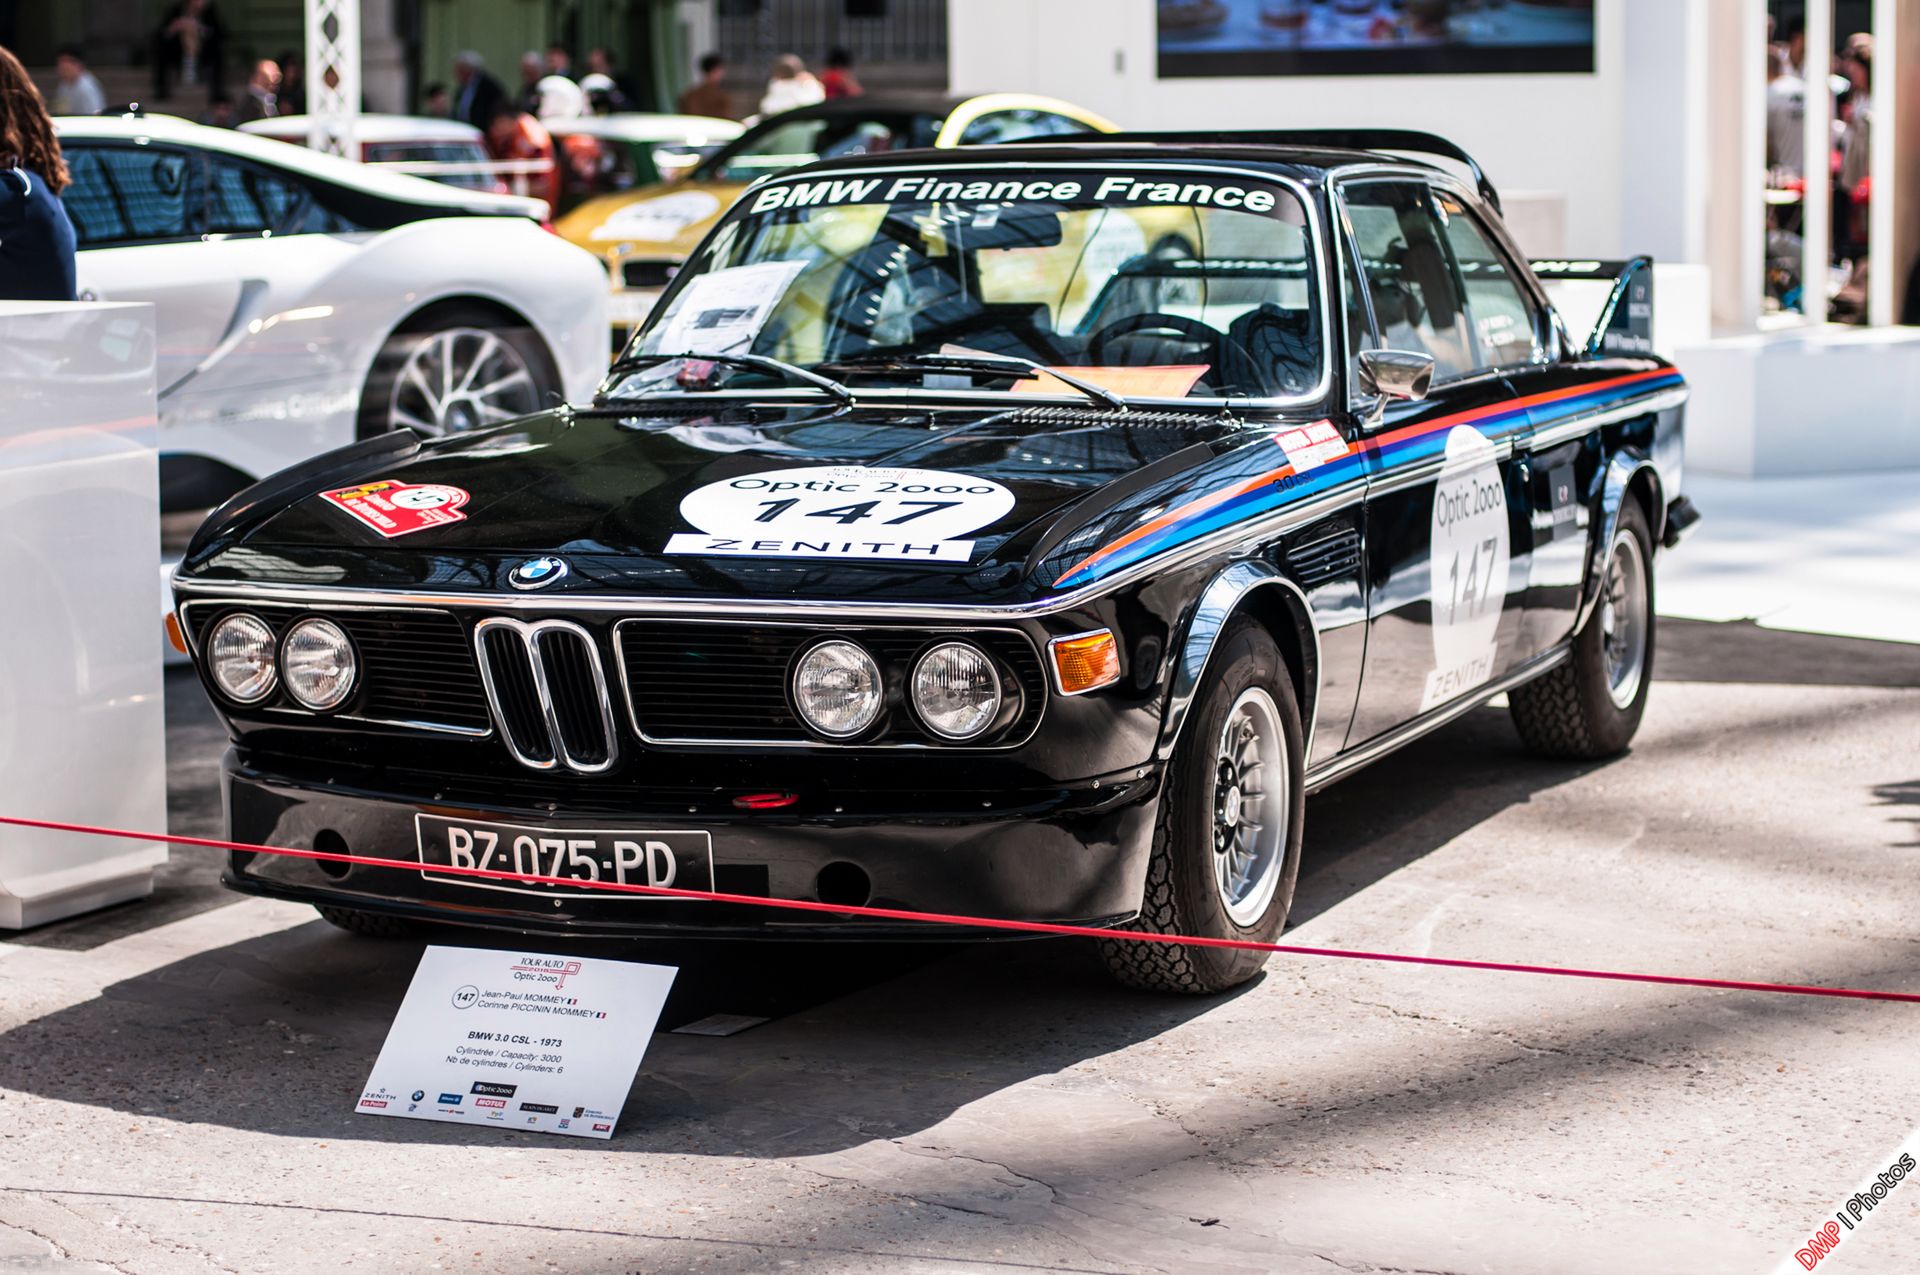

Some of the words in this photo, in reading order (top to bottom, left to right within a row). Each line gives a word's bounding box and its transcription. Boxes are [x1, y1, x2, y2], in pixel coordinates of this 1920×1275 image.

[751, 178, 883, 214] BMW
[884, 176, 1082, 201] Finance
[1094, 176, 1276, 212] France
[729, 478, 861, 493] Optic
[875, 481, 996, 495] 2000
[753, 497, 965, 525] 147
[1437, 484, 1470, 537] Optic
[1472, 479, 1502, 517] 2000
[705, 538, 942, 555] ZENITH
[1449, 536, 1499, 626] 147
[1431, 654, 1489, 699] ZENITH
[447, 826, 678, 890] BZ-075-PD
[520, 957, 542, 967] TOUR
[543, 959, 564, 969] AUTO
[513, 971, 537, 982] Optic
[537, 973, 558, 983] 2000
[456, 992, 476, 1002] 147
[481, 990, 522, 1001] Jean-Paul
[524, 994, 566, 1005] MOMMEY
[477, 999, 509, 1010] Corinne
[510, 1003, 551, 1014] PICCININ
[552, 1007, 595, 1019] MOMMEY
[468, 1030, 494, 1041] BMW
[494, 1033, 510, 1043] 3.0
[511, 1035, 531, 1045] CSL
[540, 1037, 562, 1048] 1973
[456, 1045, 494, 1057] Cylindrée
[501, 1050, 538, 1062] Capacity:
[540, 1054, 562, 1064] 3000
[445, 1055, 458, 1064] Nb
[459, 1056, 471, 1065] de
[471, 1058, 508, 1069] cylindres
[515, 1062, 556, 1073] Cylinders:
[556, 1066, 564, 1074] 6
[364, 1092, 397, 1101] ZENITH
[478, 1099, 505, 1108] MOTUL
